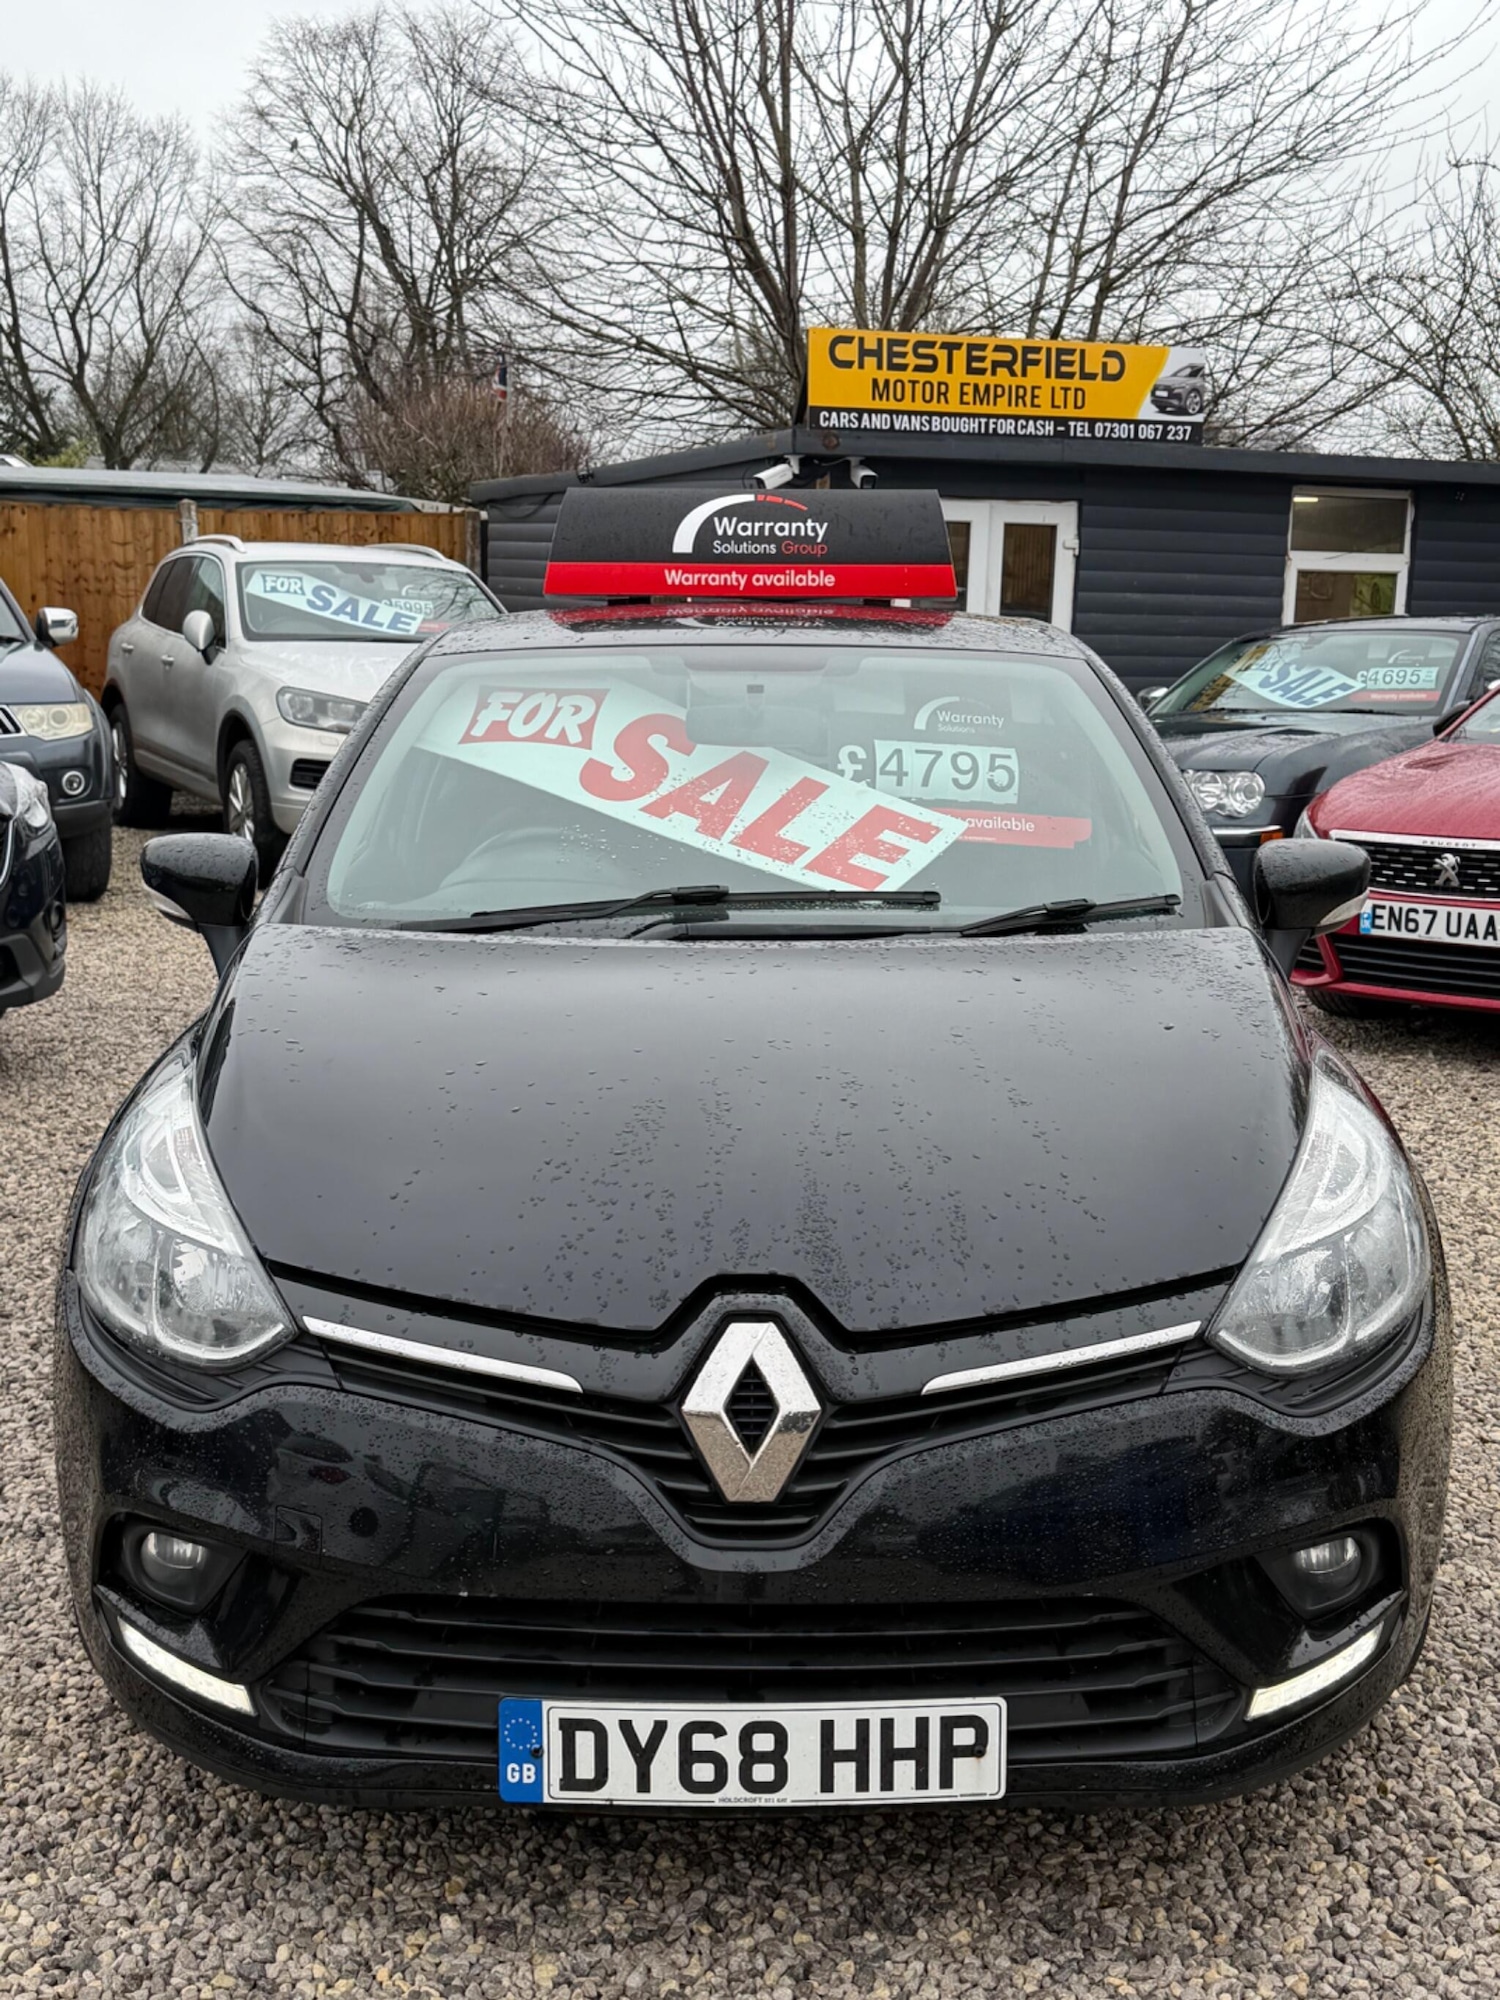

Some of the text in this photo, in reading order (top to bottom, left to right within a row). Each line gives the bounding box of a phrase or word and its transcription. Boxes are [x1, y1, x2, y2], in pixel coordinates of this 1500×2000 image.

[828, 334, 1126, 382] CHESTERFIELD
[871, 377, 1086, 410] MOTOR EMPIRE LTD
[819, 411, 859, 429] CARS
[860, 412, 891, 430] AND
[892, 414, 931, 432] VANS
[931, 416, 988, 434] BOUGHT
[988, 418, 1016, 435] FOR
[1019, 419, 1054, 436] CASH
[1068, 421, 1092, 438] TEL
[1094, 422, 1135, 439] 07301
[1138, 424, 1163, 440] 067
[1166, 425, 1192, 441] 237
[713, 516, 828, 543] Warranty
[713, 540, 828, 557] Solutions Group
[664, 568, 836, 591] Warranty available
[264, 576, 418, 634] FOR SALE
[1258, 662, 1356, 706] SALE
[936, 710, 1005, 729] Warranty
[937, 723, 976, 734] Solutions
[470, 691, 945, 889] FOR SALE
[966, 816, 1035, 832] available
[1371, 904, 1438, 935] EN67
[1446, 911, 1498, 941] UAA
[558, 1714, 990, 1795] DY68 HHP
[506, 1762, 536, 1784] GB
